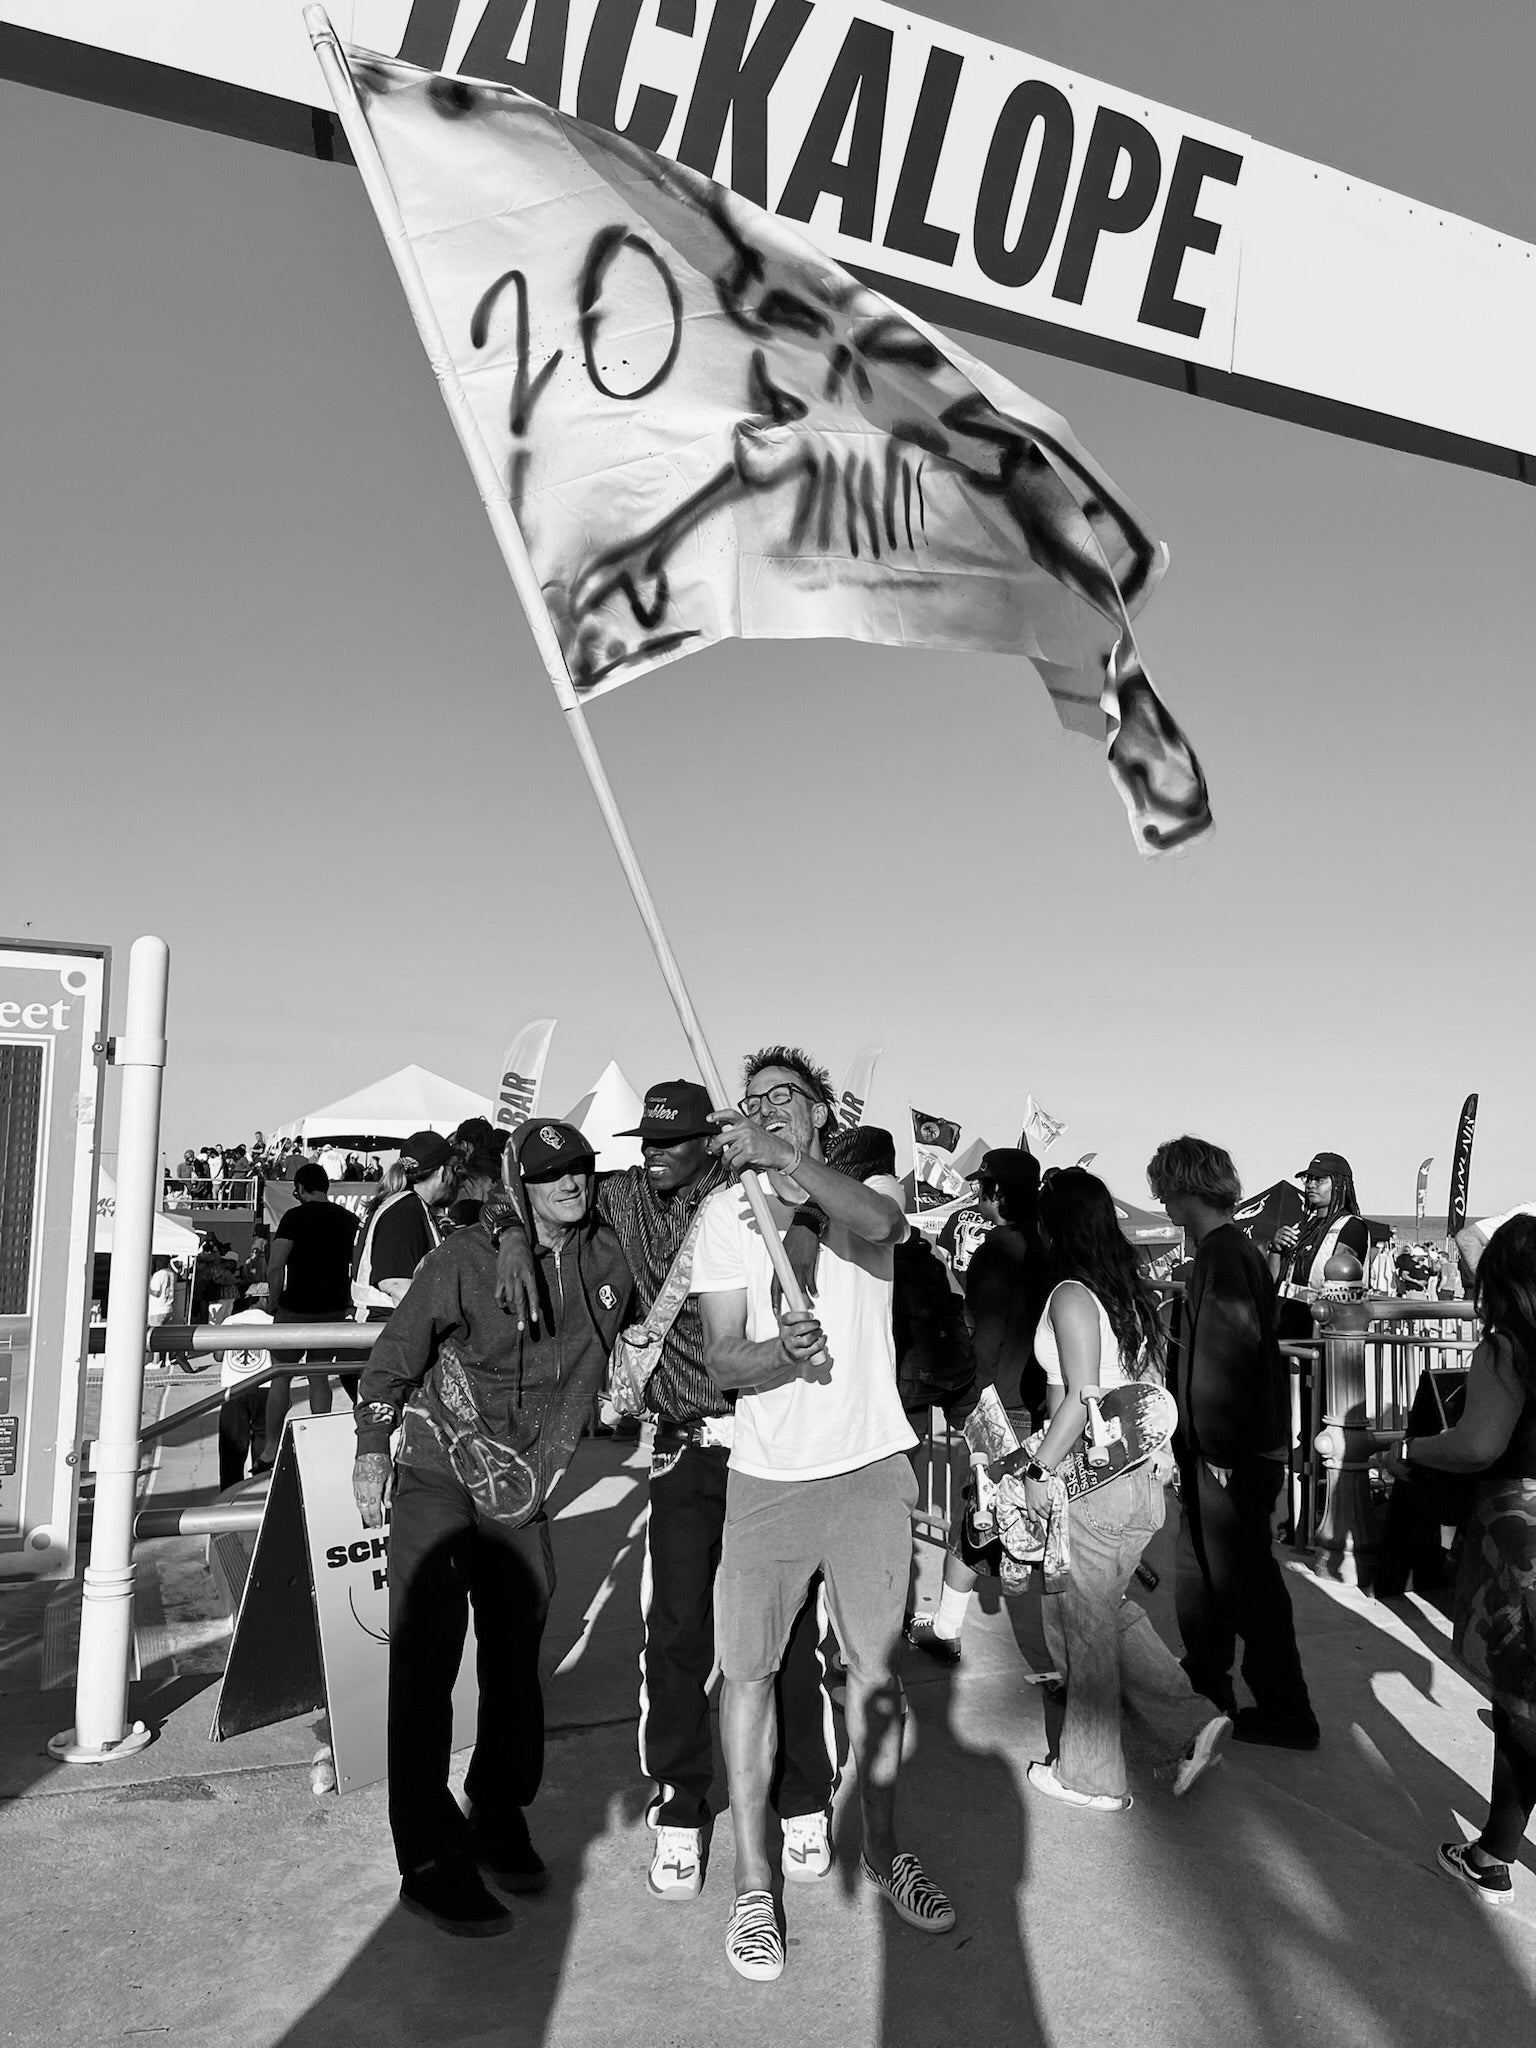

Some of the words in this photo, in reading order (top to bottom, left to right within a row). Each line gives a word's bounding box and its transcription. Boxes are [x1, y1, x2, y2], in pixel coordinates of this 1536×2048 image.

[0, 999, 71, 1031] eet
[497, 1071, 537, 1127] BAR
[326, 1536, 390, 1568] SCH
